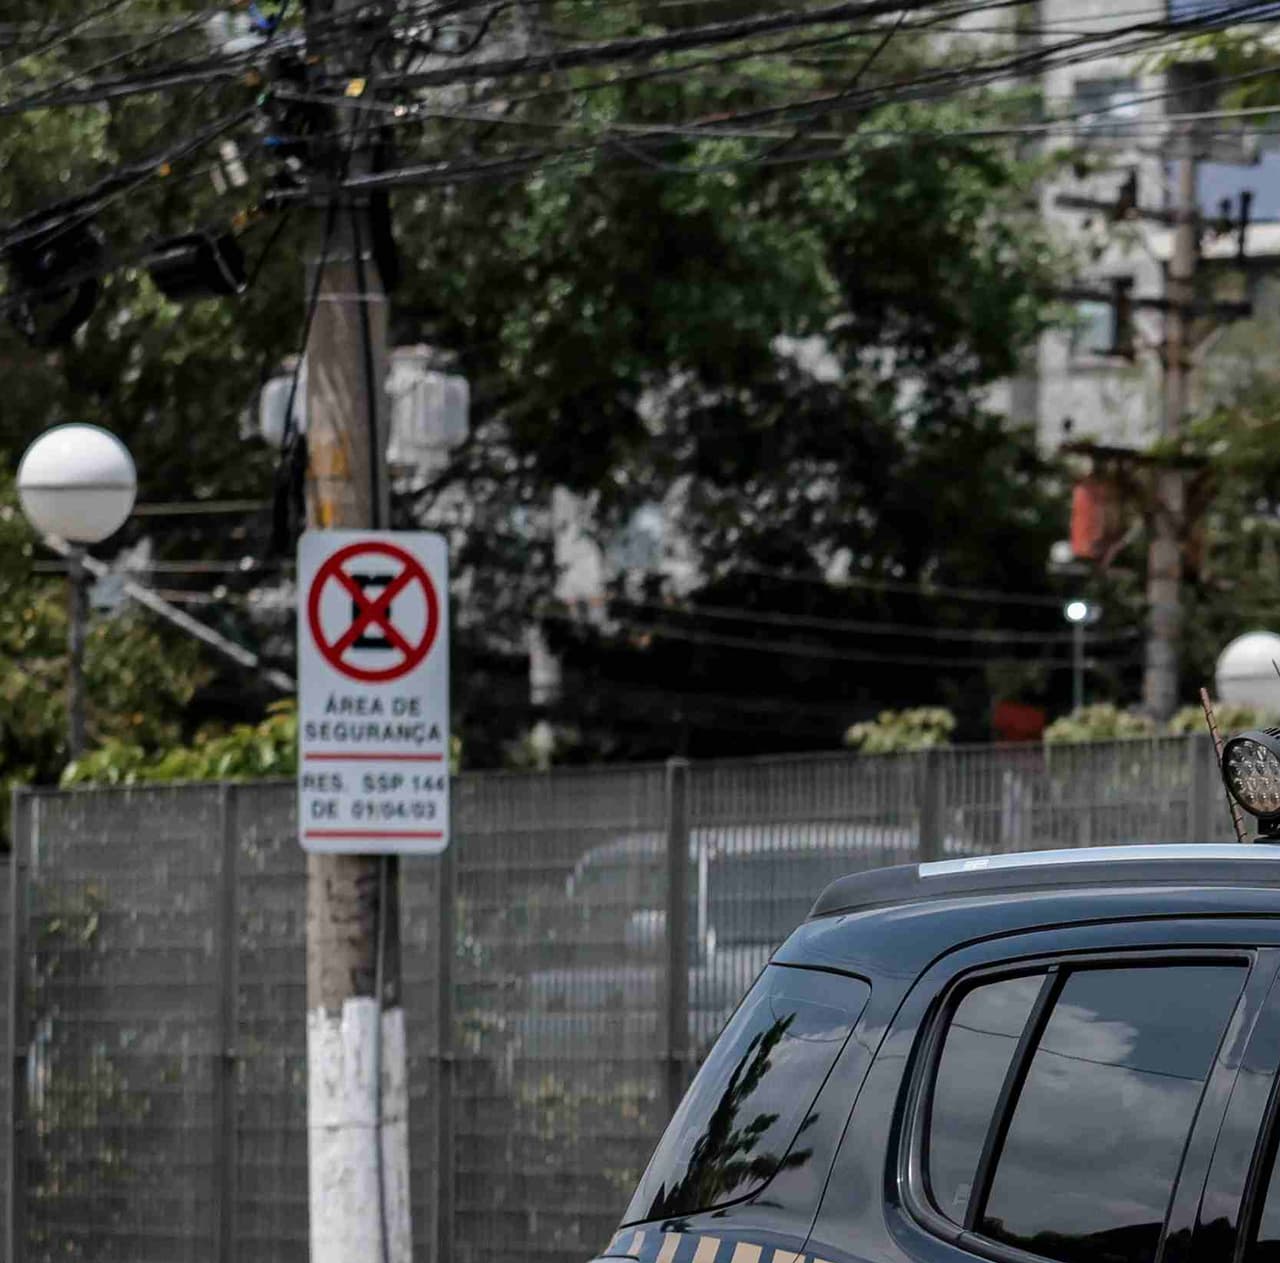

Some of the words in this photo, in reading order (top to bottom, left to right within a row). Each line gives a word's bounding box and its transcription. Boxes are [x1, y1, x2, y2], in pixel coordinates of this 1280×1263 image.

[325, 690, 384, 716] ÁREA
[391, 696, 421, 716] DE
[305, 721, 441, 746] SEGURANÇA
[363, 773, 404, 793] SSP
[311, 801, 338, 820] DE
